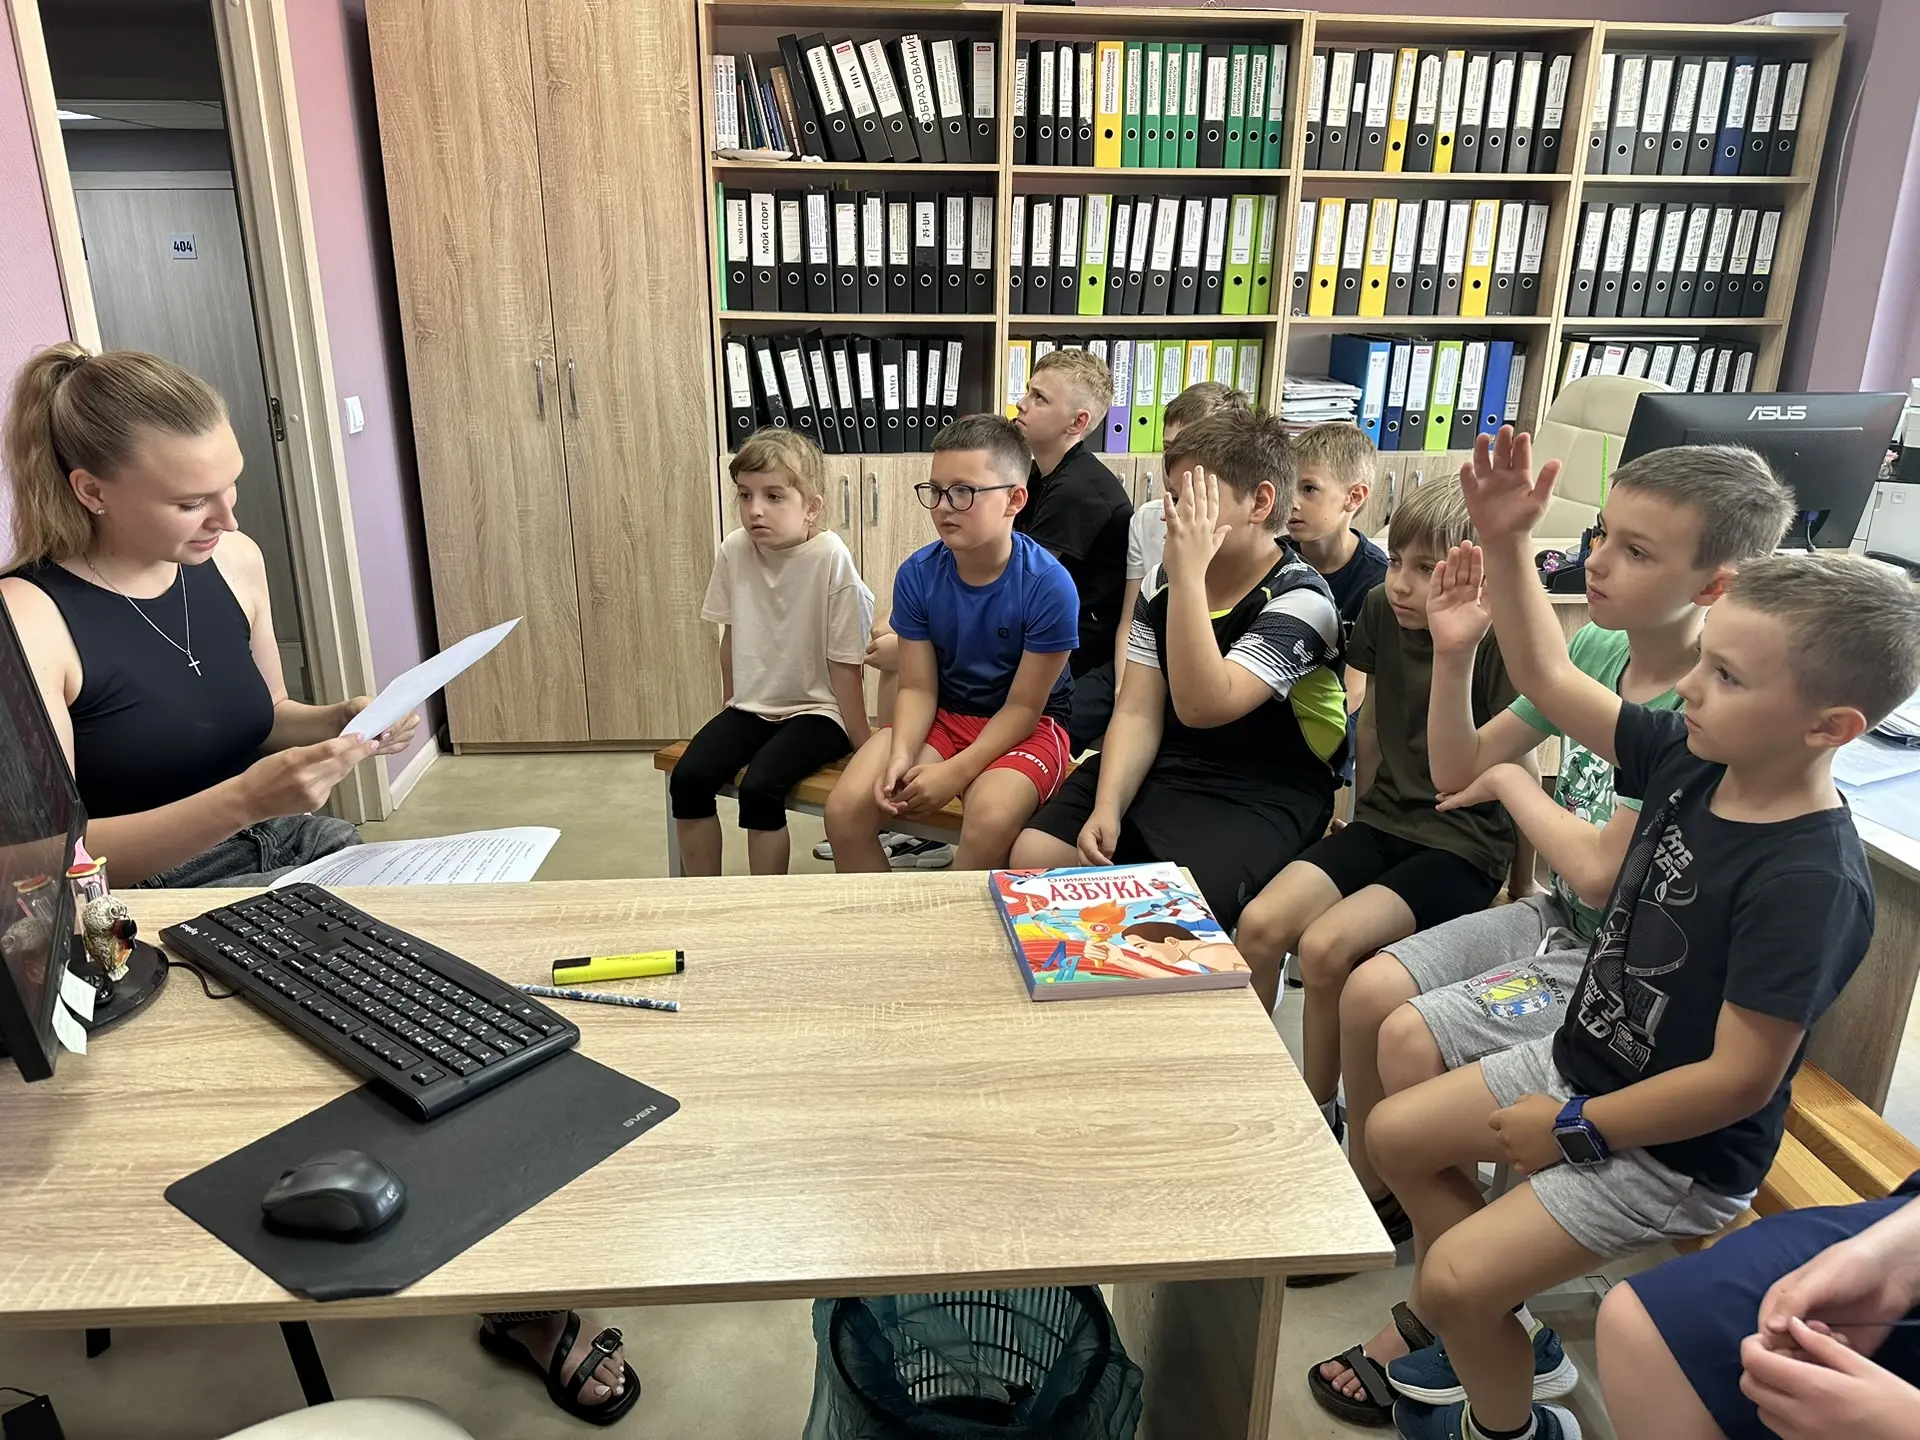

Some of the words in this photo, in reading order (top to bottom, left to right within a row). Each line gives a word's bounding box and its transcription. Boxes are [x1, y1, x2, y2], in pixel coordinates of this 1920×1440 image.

[813, 51, 837, 111] ГАРМОНИЗАЦИЯ
[870, 71, 884, 103] ПРИКАЗЫ
[905, 34, 931, 122] ОБРАЗОВАНИЕ
[1015, 59, 1026, 114] ЖУРНАЛЫ
[736, 202, 744, 227] СПОРТ
[761, 200, 769, 231] СПОРТ
[173, 240, 193, 253] 404
[737, 227, 745, 244] МОЙ
[760, 232, 770, 254] МОЙ
[1747, 405, 1807, 421] ASUS
[1047, 873, 1136, 884] Олимпийская
[1049, 880, 1153, 902] АЗБУКА
[1545, 976, 1567, 1005] SKATE
[622, 1104, 659, 1128] SVEN
